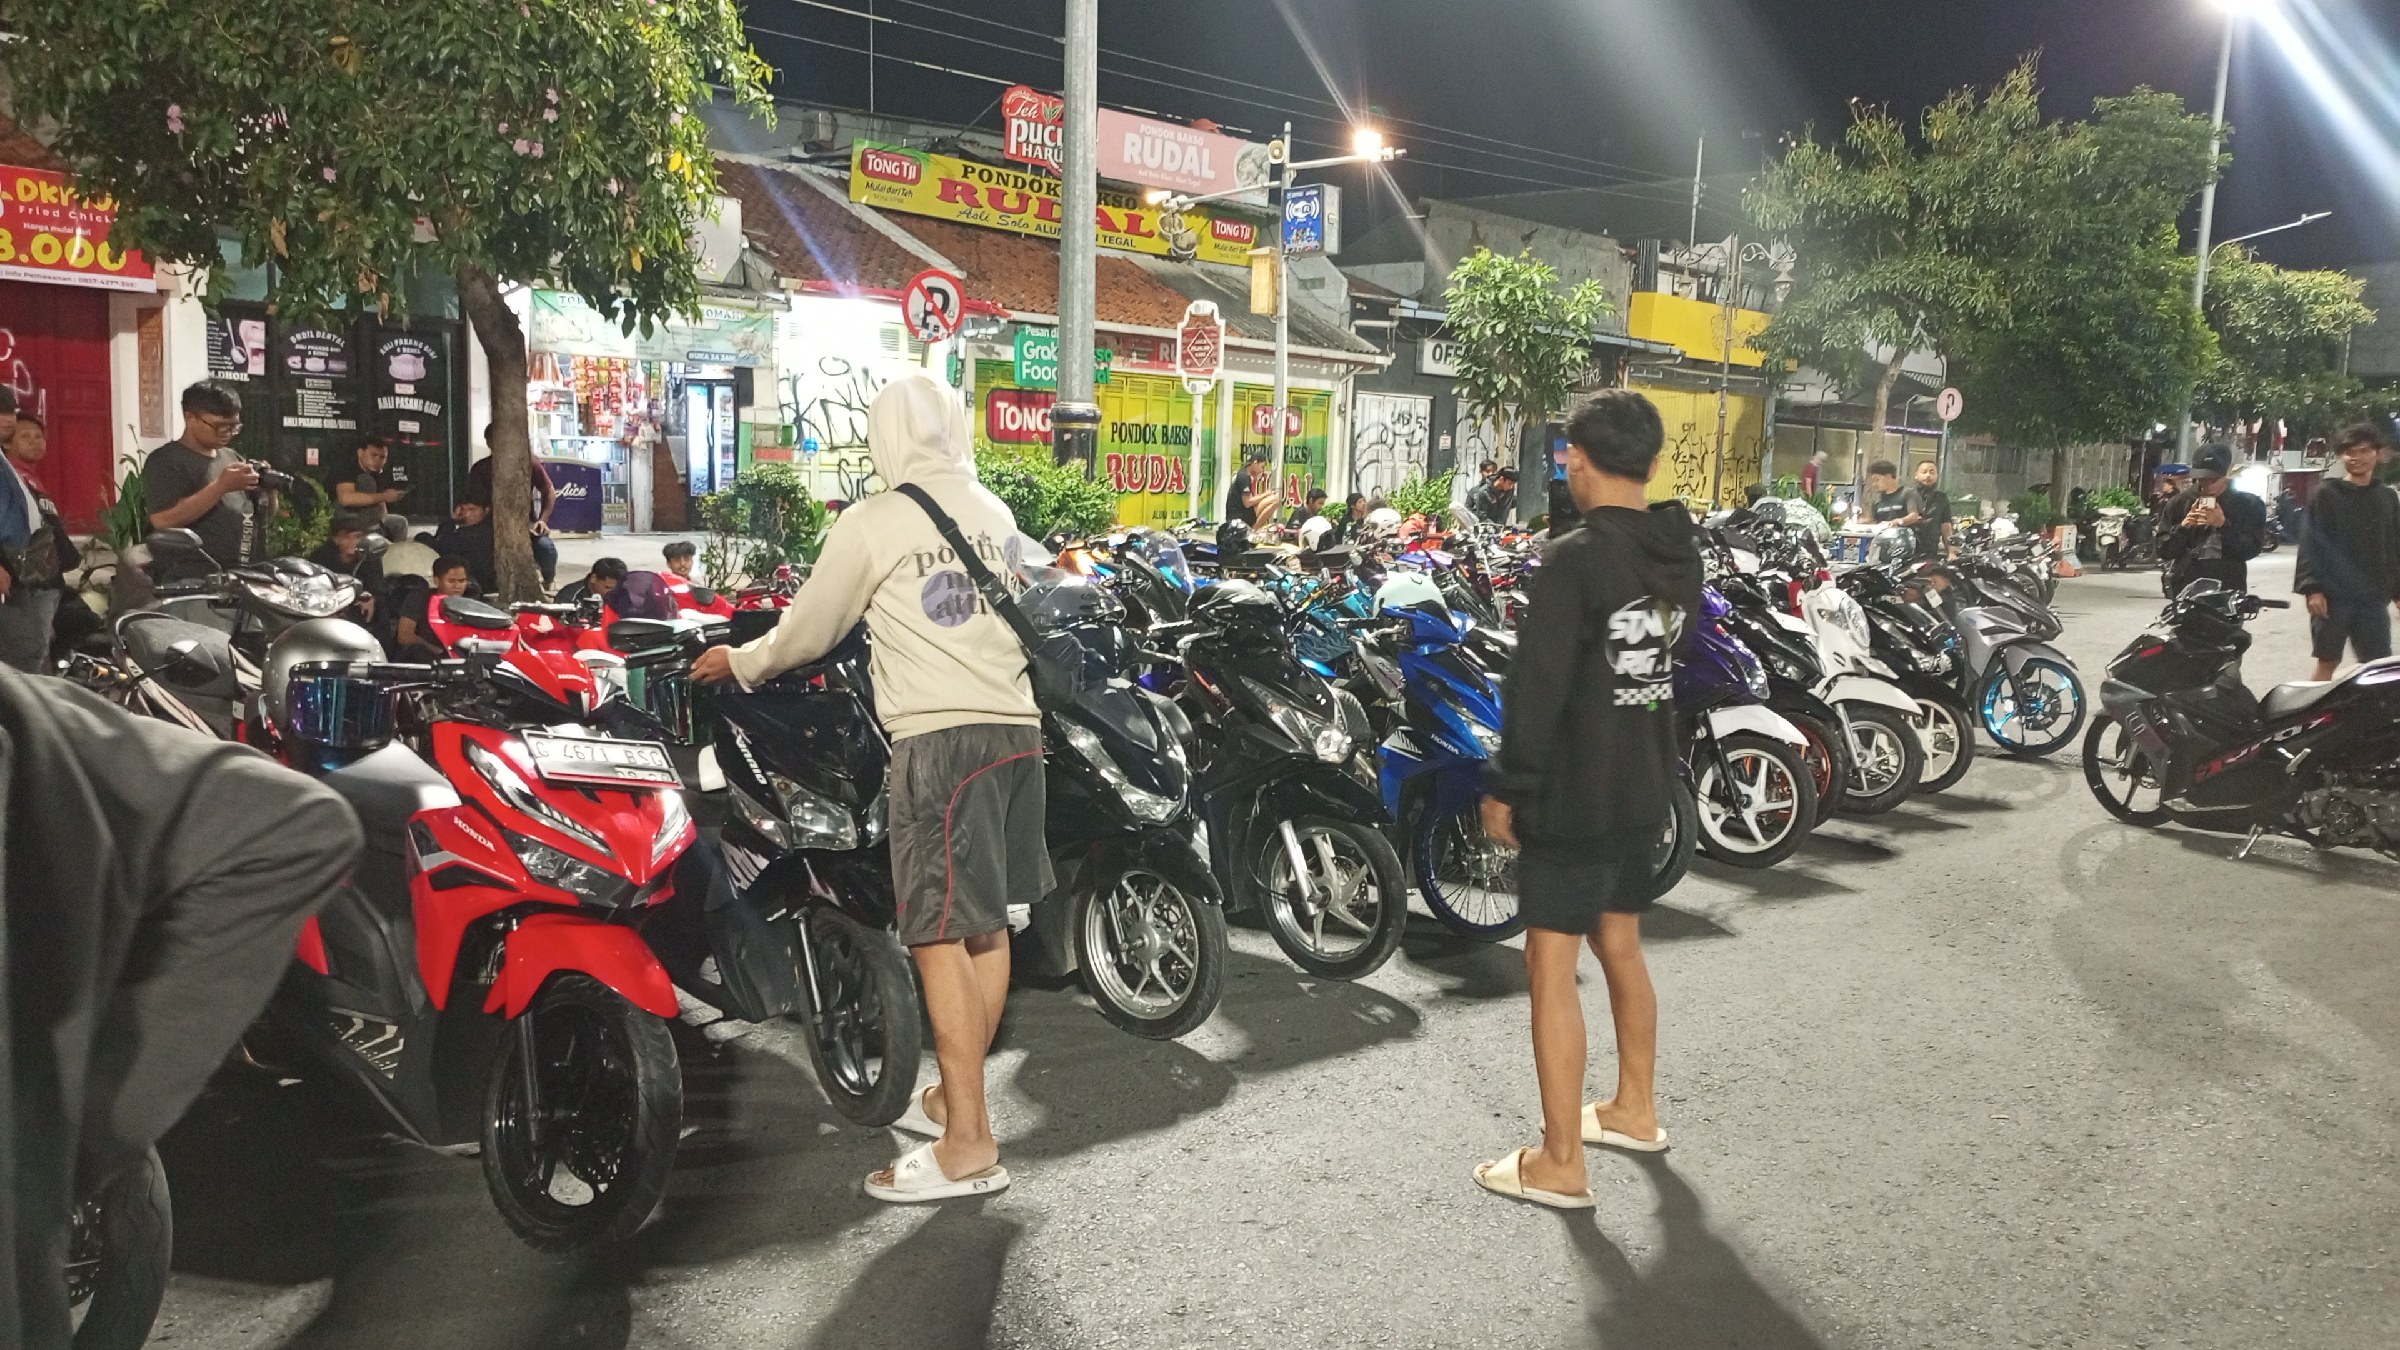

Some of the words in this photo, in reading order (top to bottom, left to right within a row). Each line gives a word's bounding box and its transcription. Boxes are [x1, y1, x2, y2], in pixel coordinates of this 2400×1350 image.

[1006, 95, 1038, 119] Teh
[1009, 118, 1063, 154] puc
[1140, 123, 1175, 141] PONDOK
[1177, 130, 1204, 147] BAKSO
[867, 154, 899, 175] TONG
[1123, 133, 1215, 180] RUDAL
[18, 205, 60, 218] Fried
[1215, 220, 1239, 236] TONG
[1102, 234, 1136, 248] TEGAL
[1025, 325, 1049, 338] Pesan
[996, 401, 1052, 432] TONG
[1111, 422, 1157, 444] PONDOK
[1161, 425, 1192, 446] BAKS
[1106, 452, 1187, 494] RUDA
[555, 482, 588, 498] Aice
[1431, 733, 1459, 755] HONDA
[453, 815, 496, 852] HONDA
